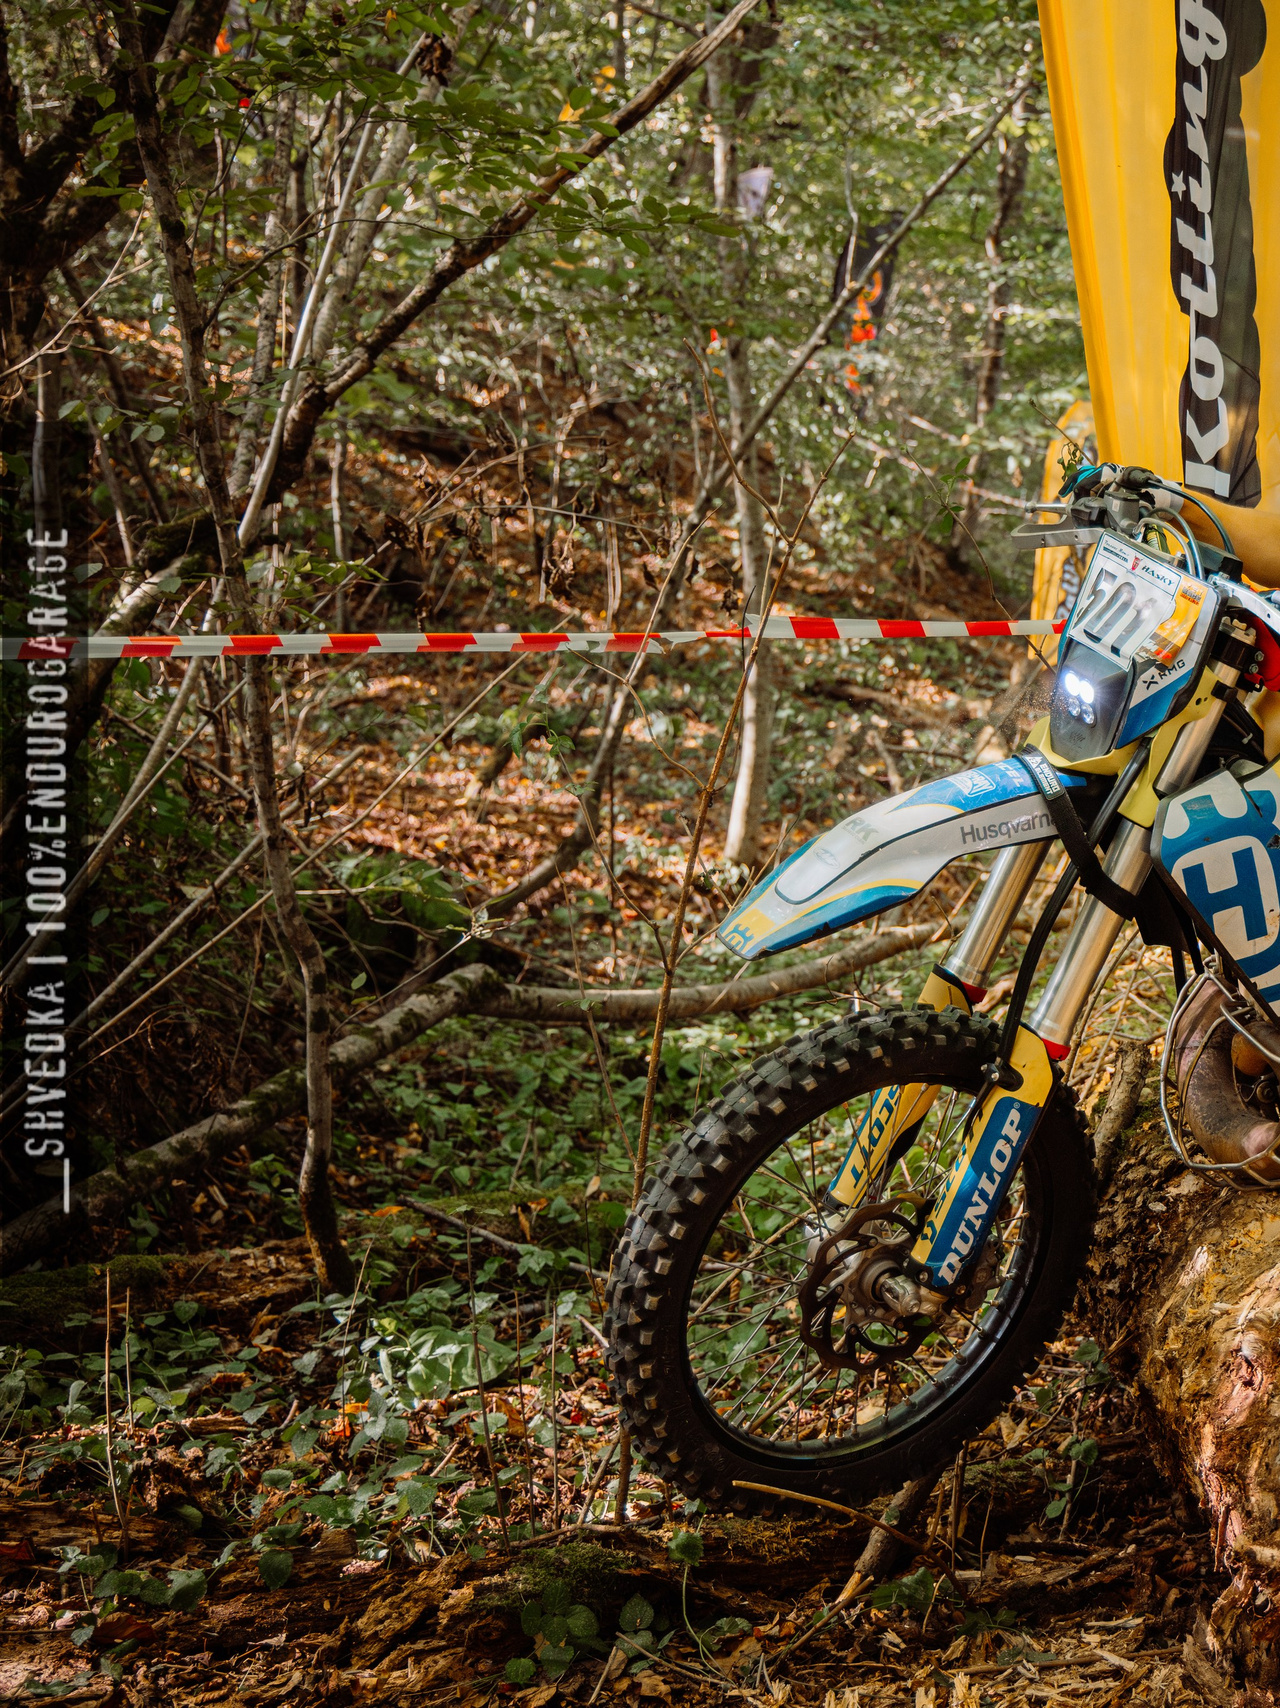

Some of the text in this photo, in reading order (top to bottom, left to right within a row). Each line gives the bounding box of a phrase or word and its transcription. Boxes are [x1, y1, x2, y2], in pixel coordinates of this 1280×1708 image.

[1041, 762, 1061, 793] ENDURO
[960, 812, 1054, 845] Husqvarn
[937, 1109, 1022, 1284] DUNLOP
